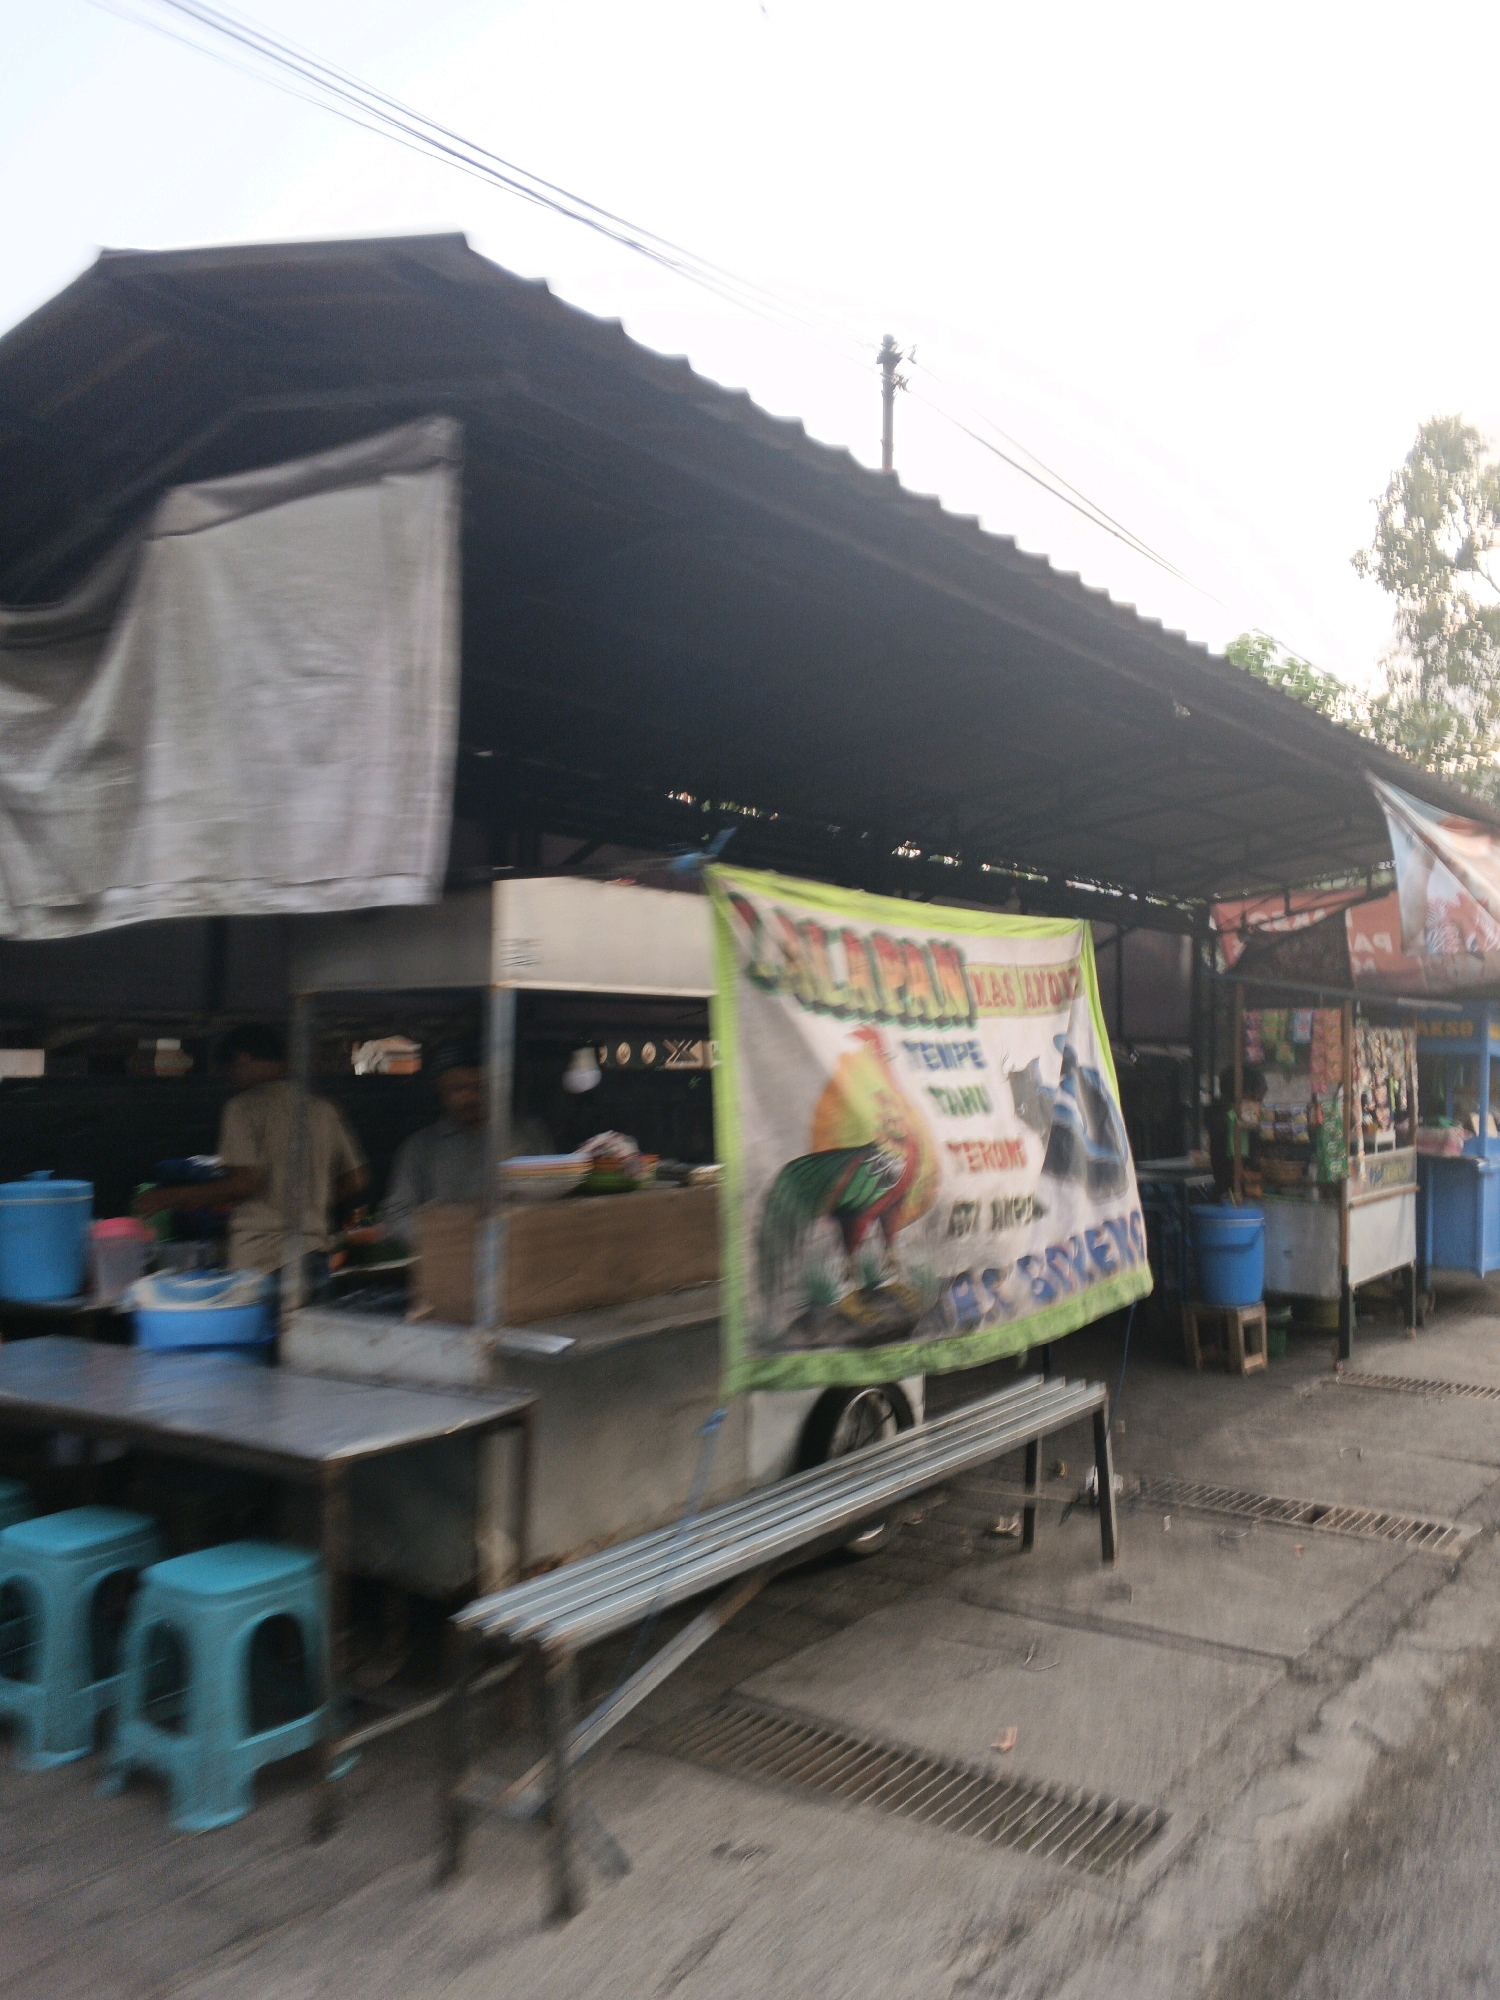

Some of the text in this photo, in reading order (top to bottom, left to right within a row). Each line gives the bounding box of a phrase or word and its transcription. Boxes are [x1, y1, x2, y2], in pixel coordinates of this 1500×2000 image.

[1416, 1020, 1474, 1038] AKSO
[900, 1038, 988, 1072] TEMPE
[926, 1083, 995, 1117] TAHU
